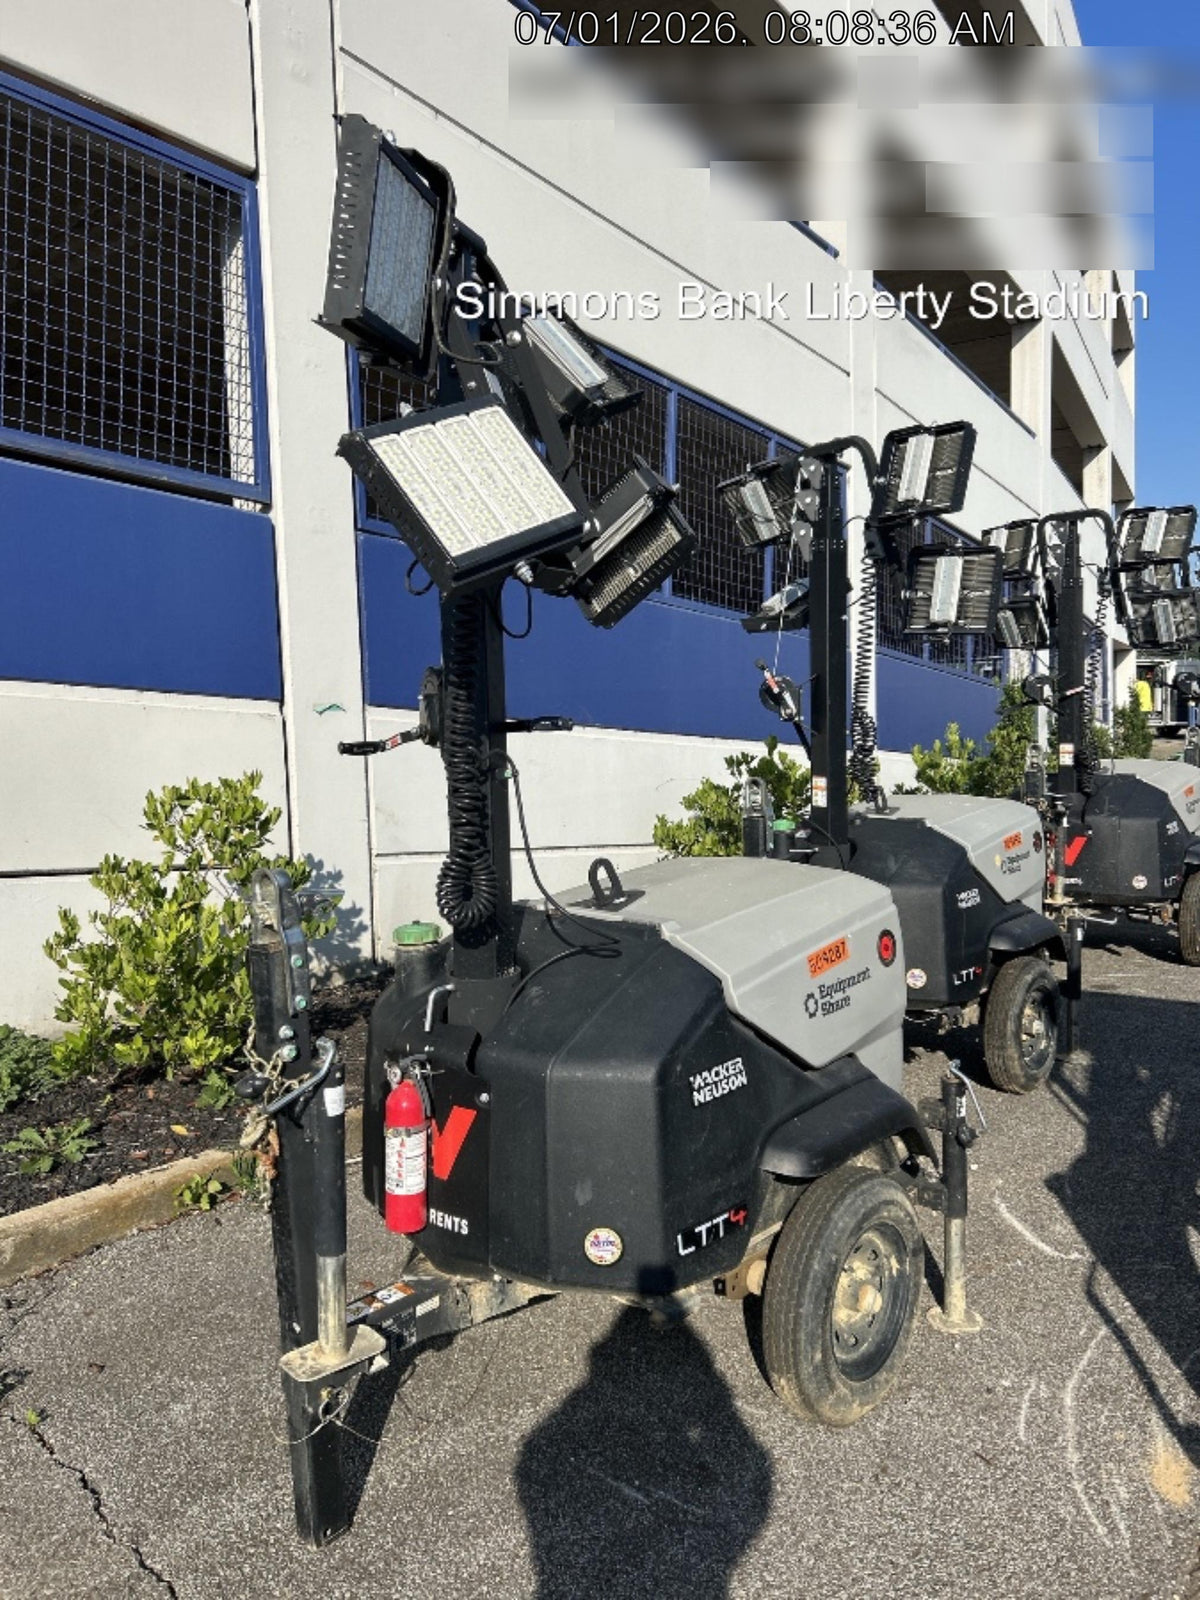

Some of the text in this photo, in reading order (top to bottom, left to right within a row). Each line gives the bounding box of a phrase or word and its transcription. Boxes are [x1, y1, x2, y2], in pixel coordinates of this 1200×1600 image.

[818, 966, 871, 999] Equipment
[820, 994, 851, 1017] Share
[689, 1057, 745, 1090] WACKER
[692, 1071, 748, 1107] NEUSON
[429, 1208, 469, 1235] RENTS
[676, 1208, 748, 1256] LTT4
